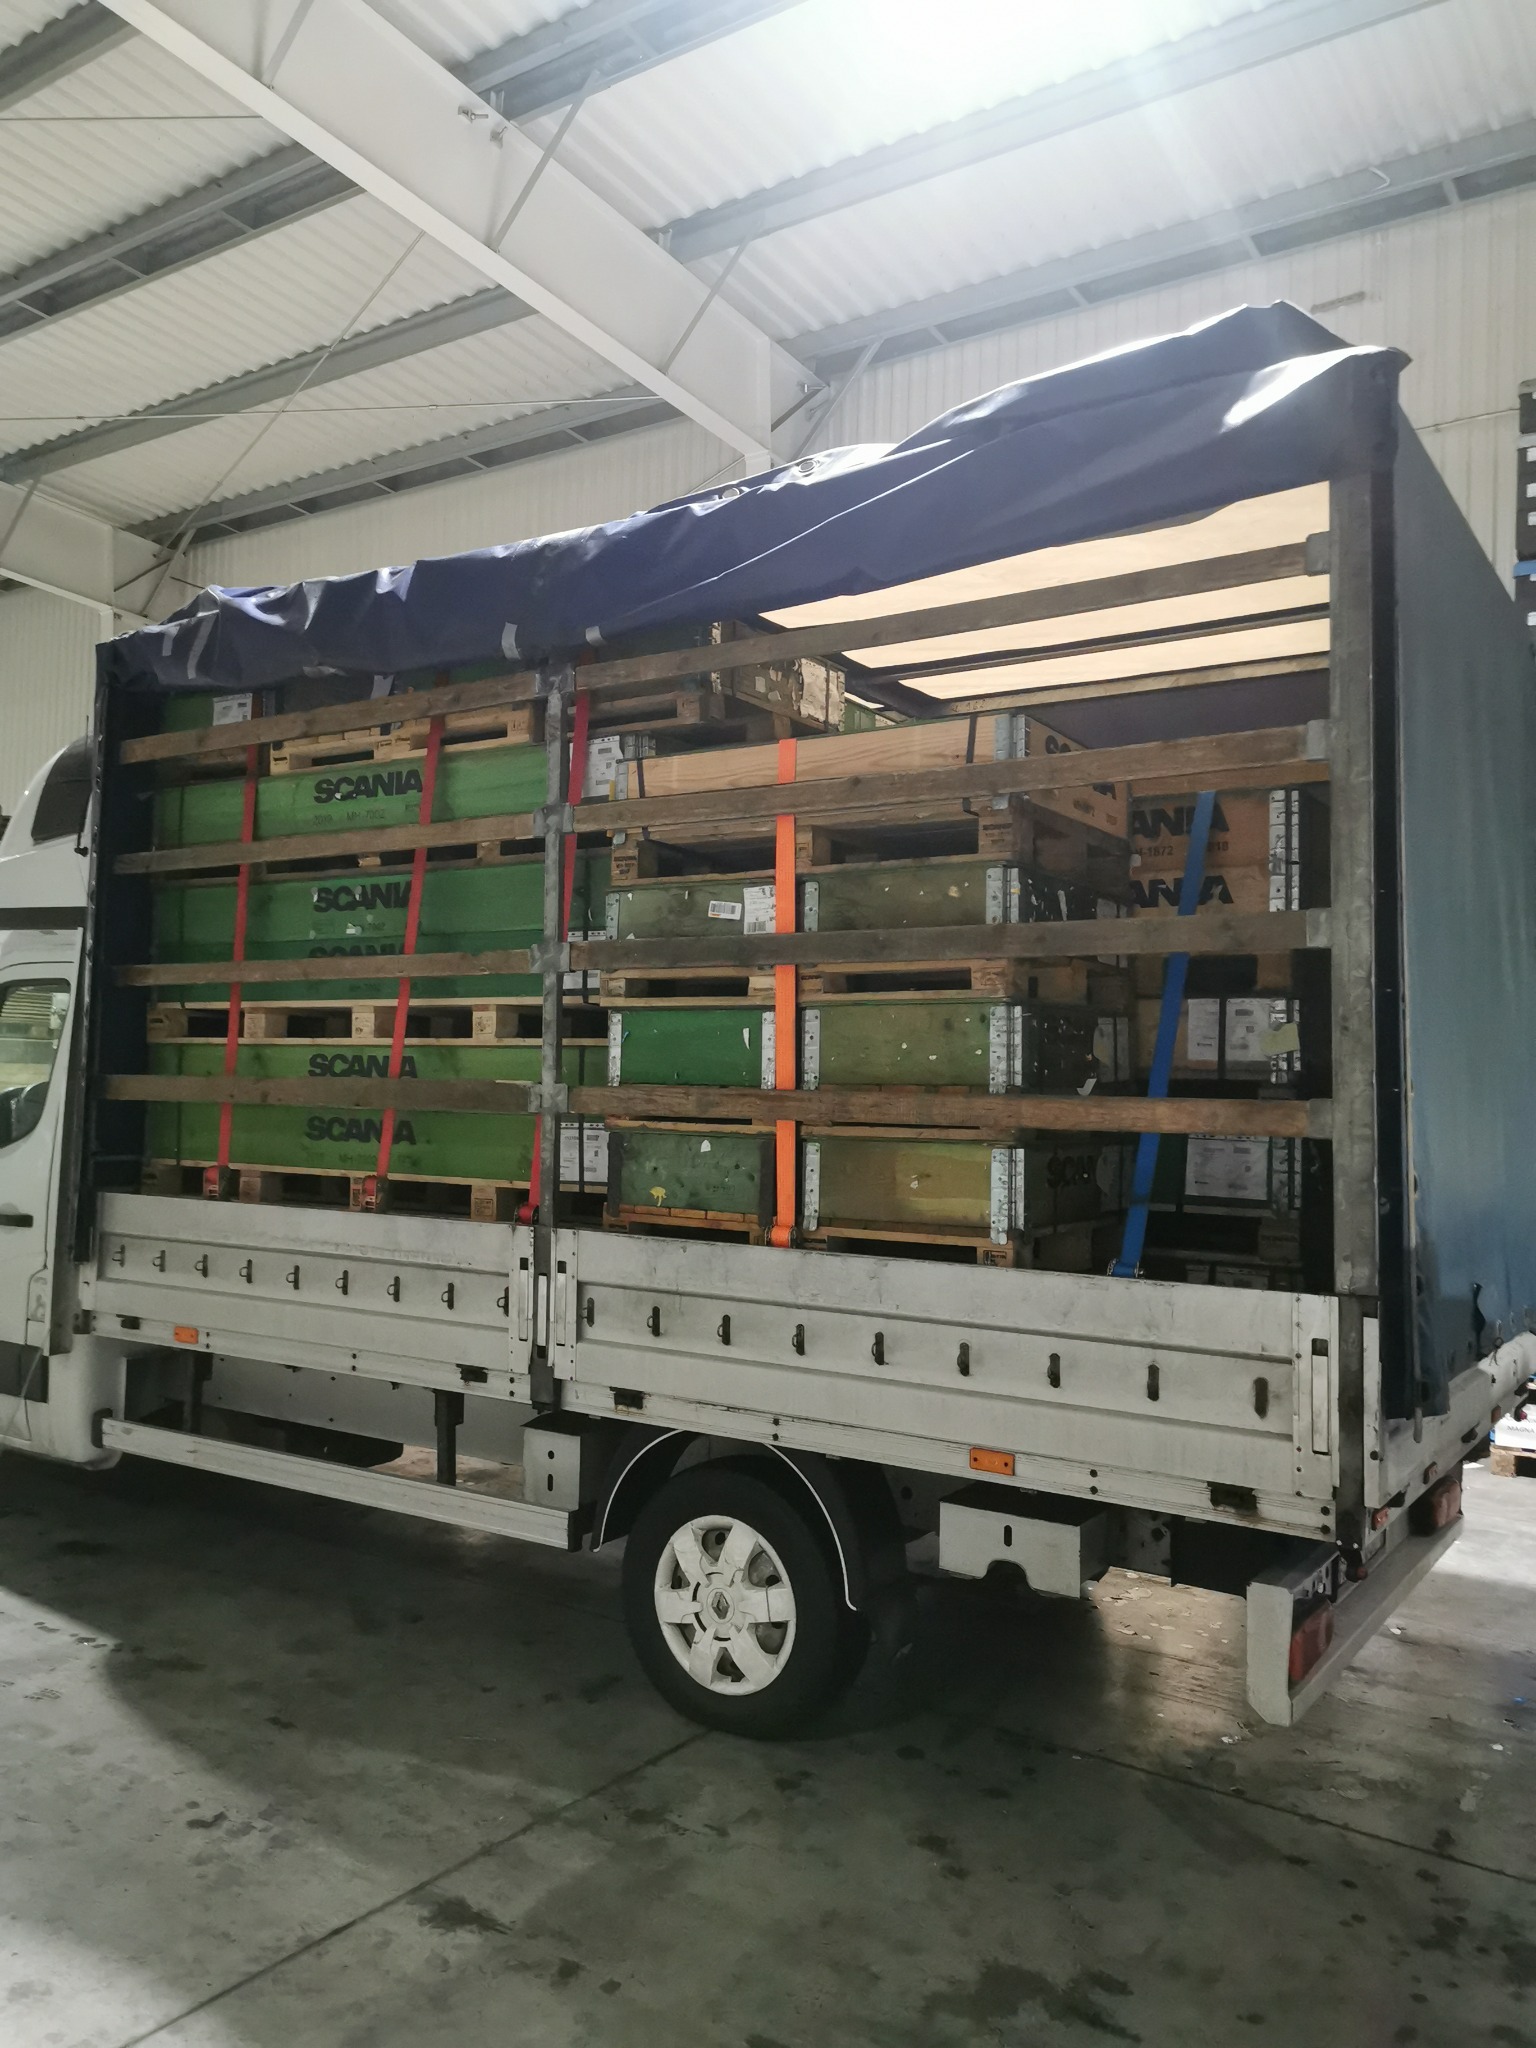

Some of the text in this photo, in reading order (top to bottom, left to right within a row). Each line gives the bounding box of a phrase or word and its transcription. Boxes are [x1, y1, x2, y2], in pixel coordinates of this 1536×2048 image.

[313, 769, 423, 804] SCANIA
[1132, 803, 1230, 838] ANIA
[1131, 875, 1233, 908] ANA
[308, 1053, 418, 1079] SCANA
[304, 1115, 417, 1145] SCANA
